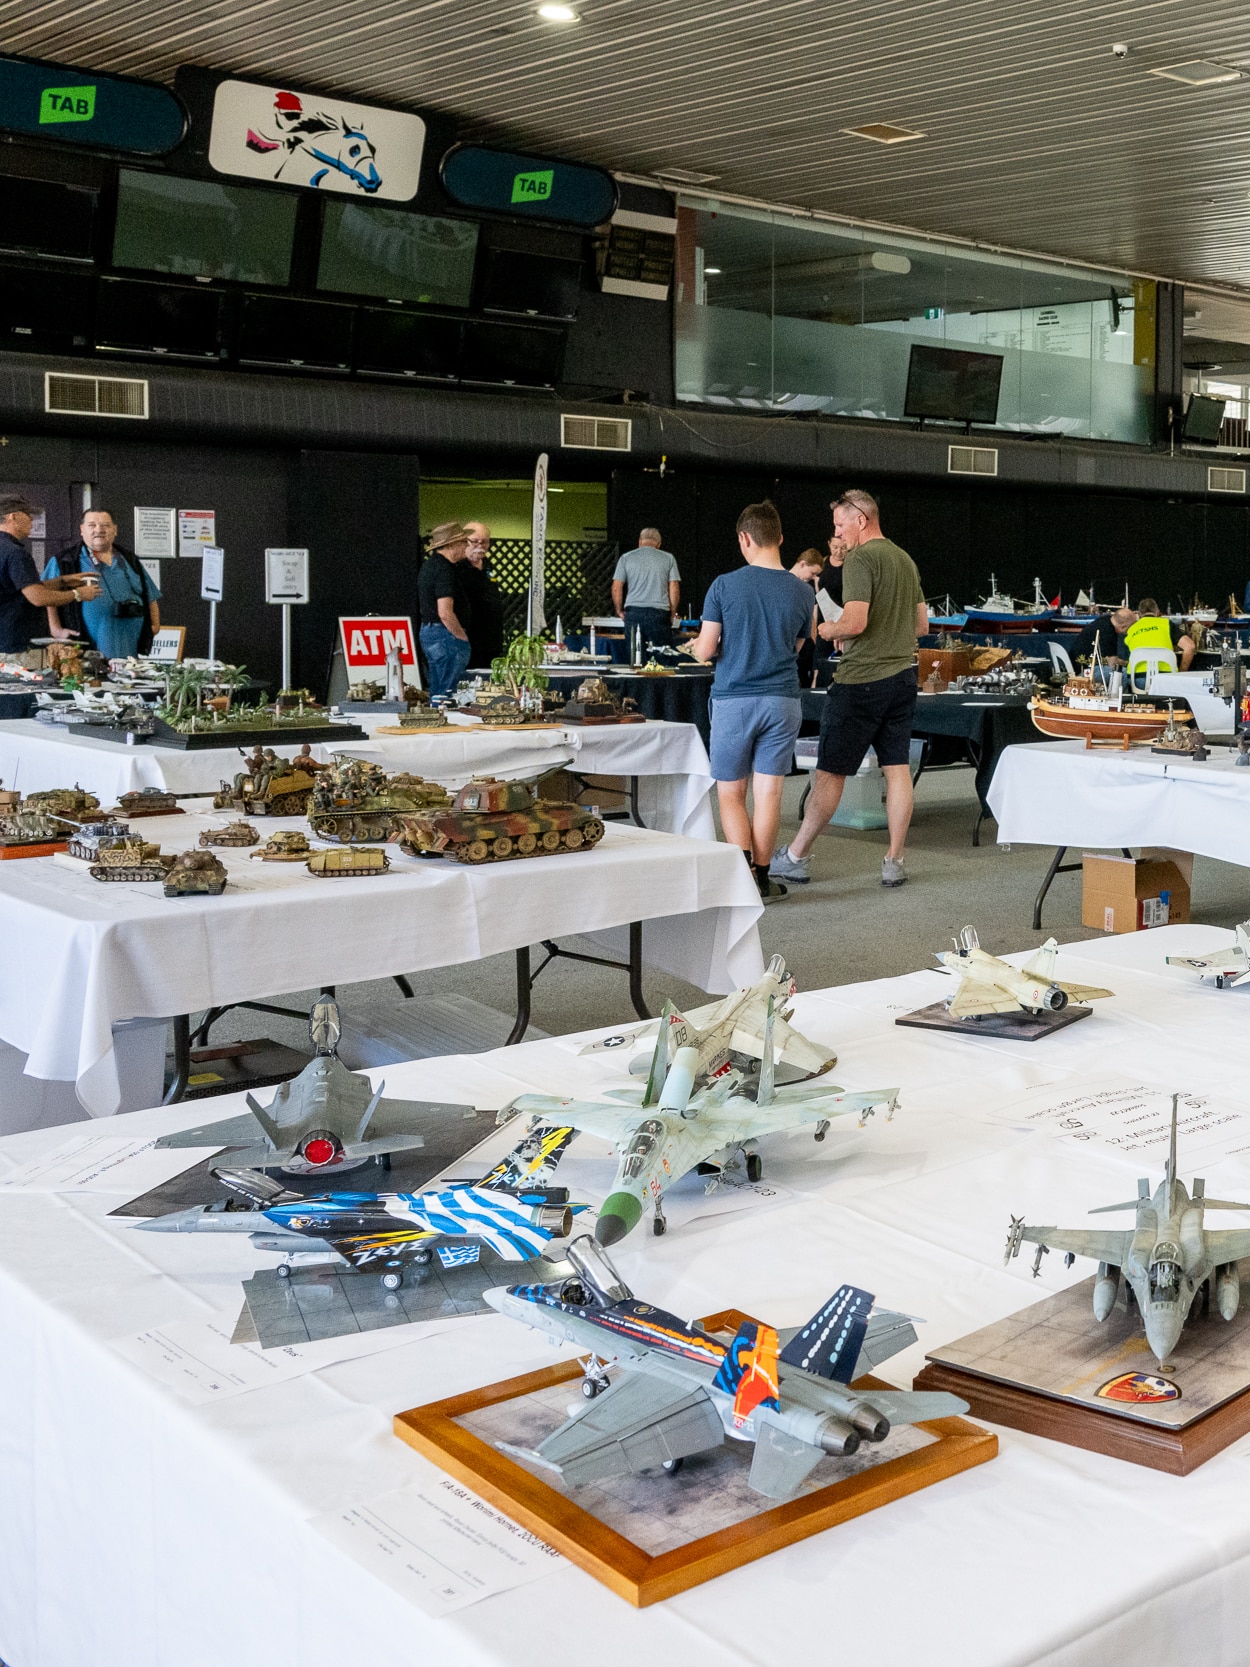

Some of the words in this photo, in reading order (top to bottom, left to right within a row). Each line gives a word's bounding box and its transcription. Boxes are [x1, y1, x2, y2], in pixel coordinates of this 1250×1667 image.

[48, 93, 89, 115] TAB
[519, 178, 548, 195] TAB
[350, 629, 409, 655] ATM
